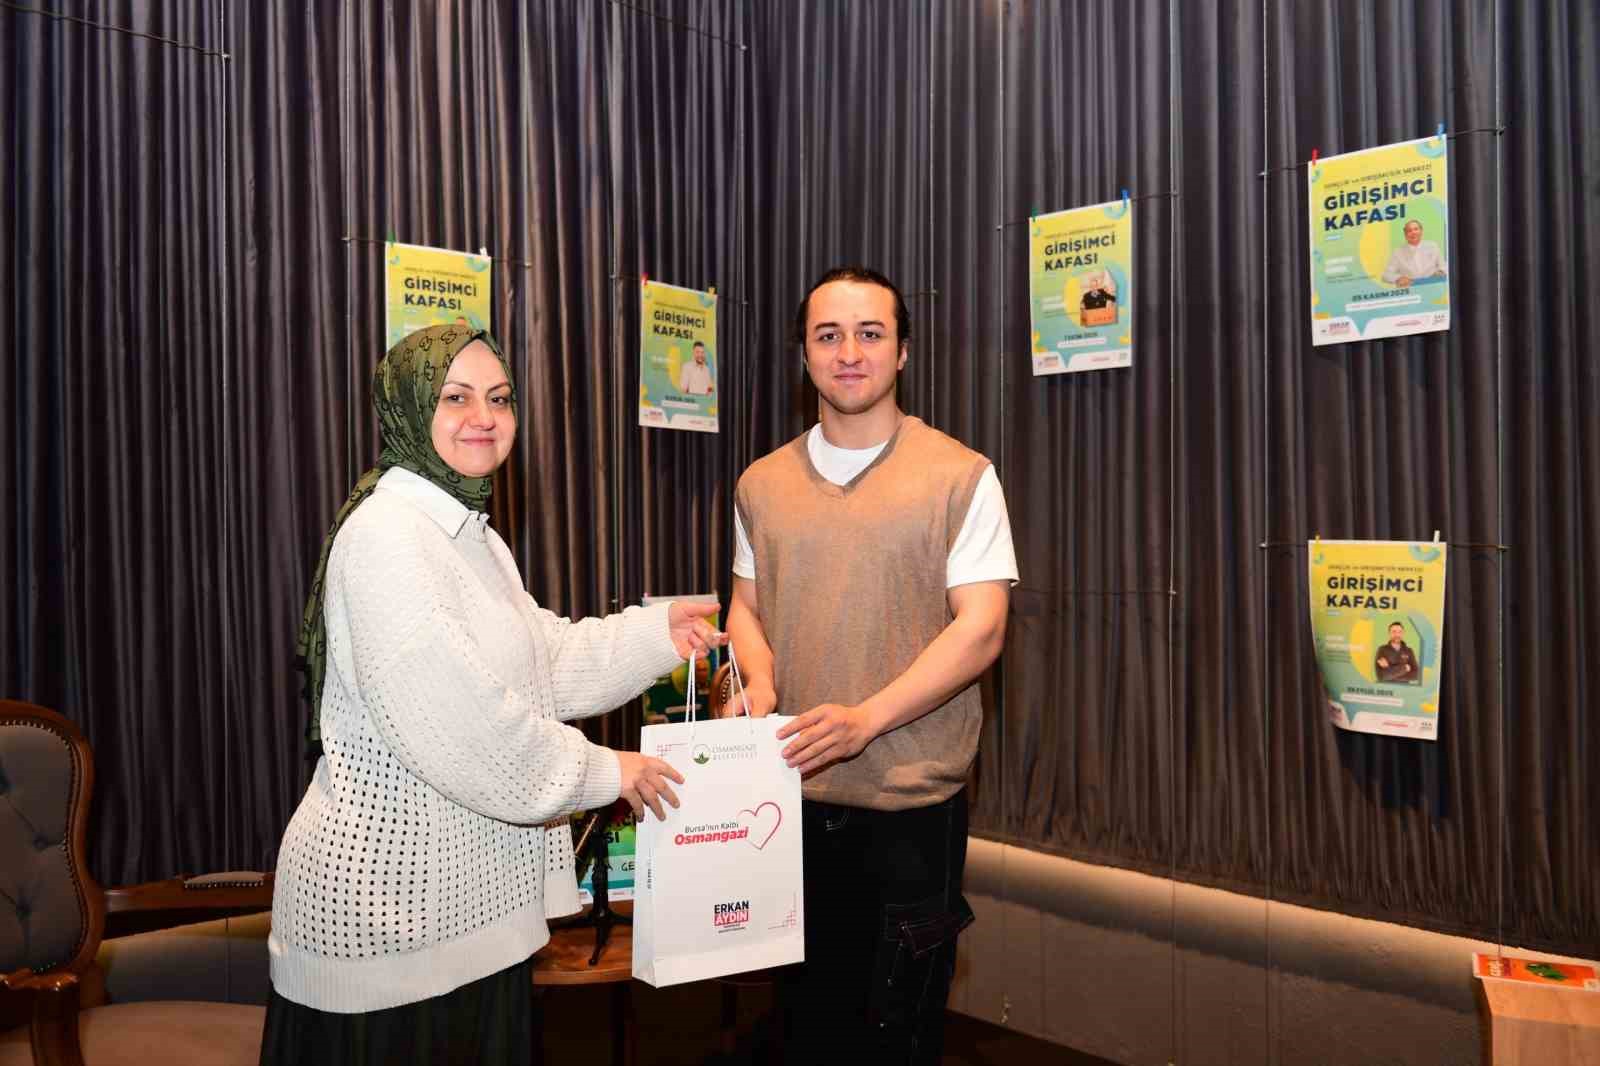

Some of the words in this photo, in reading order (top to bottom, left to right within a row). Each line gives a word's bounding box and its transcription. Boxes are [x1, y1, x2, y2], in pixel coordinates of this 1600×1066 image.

[1323, 174, 1433, 211] GİRİŞİMCİ
[1324, 203, 1406, 232] KAFASI
[1043, 231, 1116, 256] GİRİŞİMCİ
[1044, 253, 1099, 273] KAFASI
[404, 293, 462, 310] KAFASI
[653, 324, 694, 340] KAFASI
[1327, 573, 1424, 593] GİRİŞİMCİ
[1326, 594, 1398, 610] KAFASI
[674, 826, 749, 846] Osmangazi
[714, 900, 749, 914] ERKAN
[715, 911, 748, 925] AYDIN
